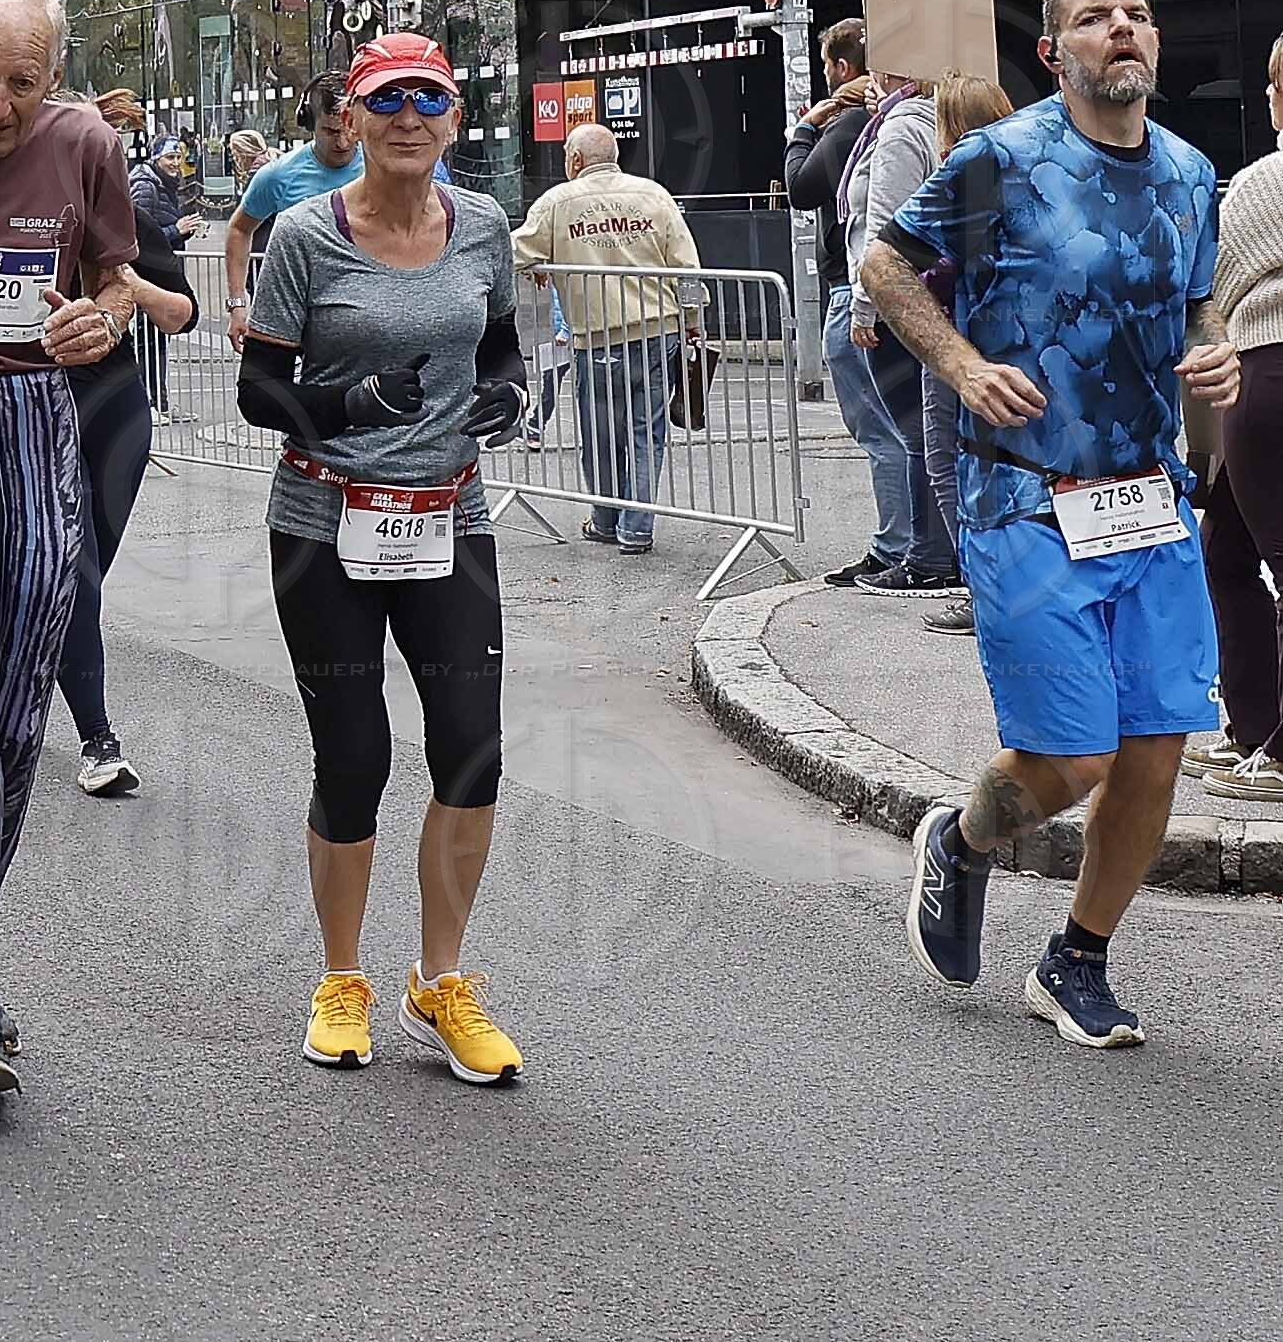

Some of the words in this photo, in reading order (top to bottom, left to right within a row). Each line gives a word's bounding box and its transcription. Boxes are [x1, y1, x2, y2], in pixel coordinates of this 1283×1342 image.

[538, 100, 558, 118] K&O
[566, 94, 593, 114] giga
[568, 112, 593, 125] sport
[27, 218, 57, 228] GRAZ
[568, 217, 654, 240] MadMax
[1089, 485, 1145, 512] 2758
[375, 517, 425, 539] 4618
[1111, 521, 1142, 533] Patrick
[379, 552, 414, 561] Elisabeth
